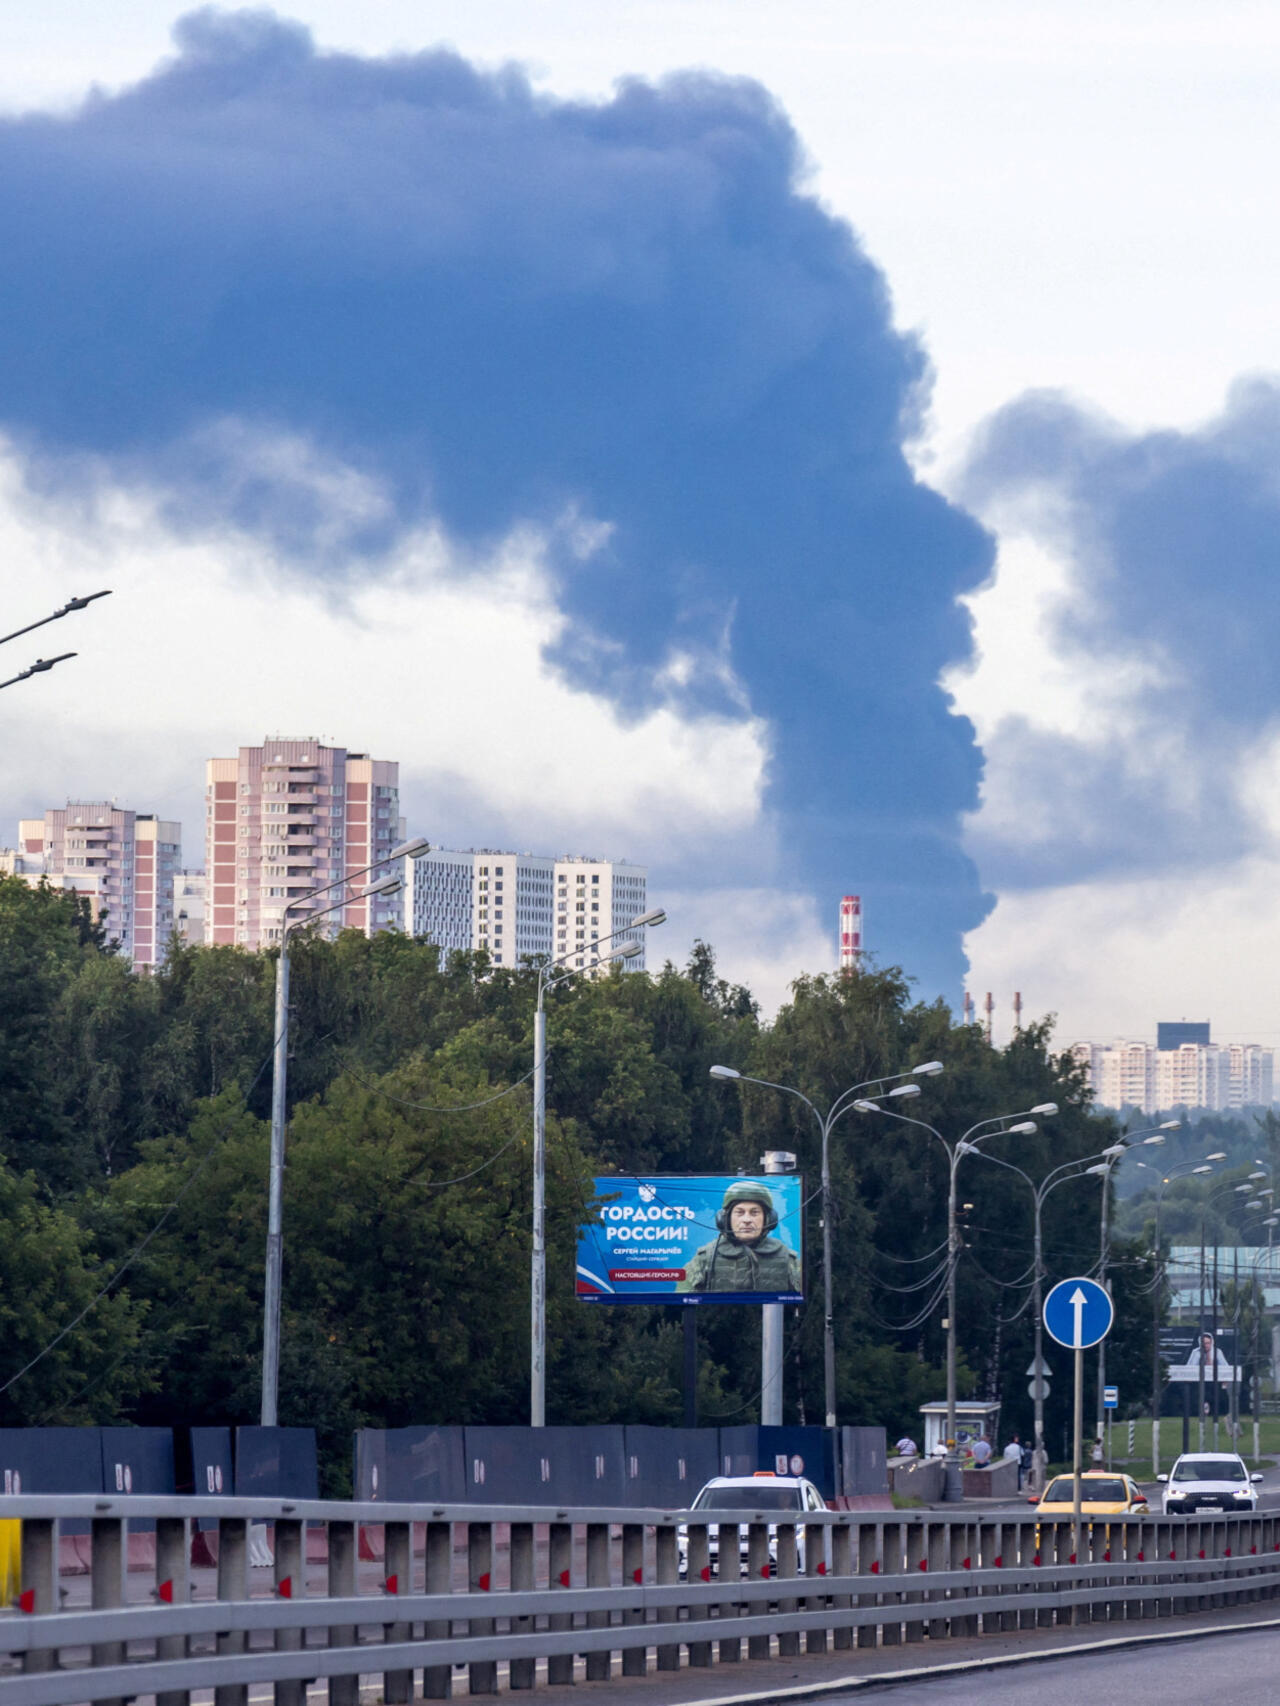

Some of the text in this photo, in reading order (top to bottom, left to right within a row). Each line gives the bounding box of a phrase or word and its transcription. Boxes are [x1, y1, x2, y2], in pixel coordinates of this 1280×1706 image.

[600, 1206, 695, 1222] ГОРДОСТЬ
[607, 1226, 688, 1240] РОССИИ!
[613, 1247, 638, 1255] СЕРГЕЙ
